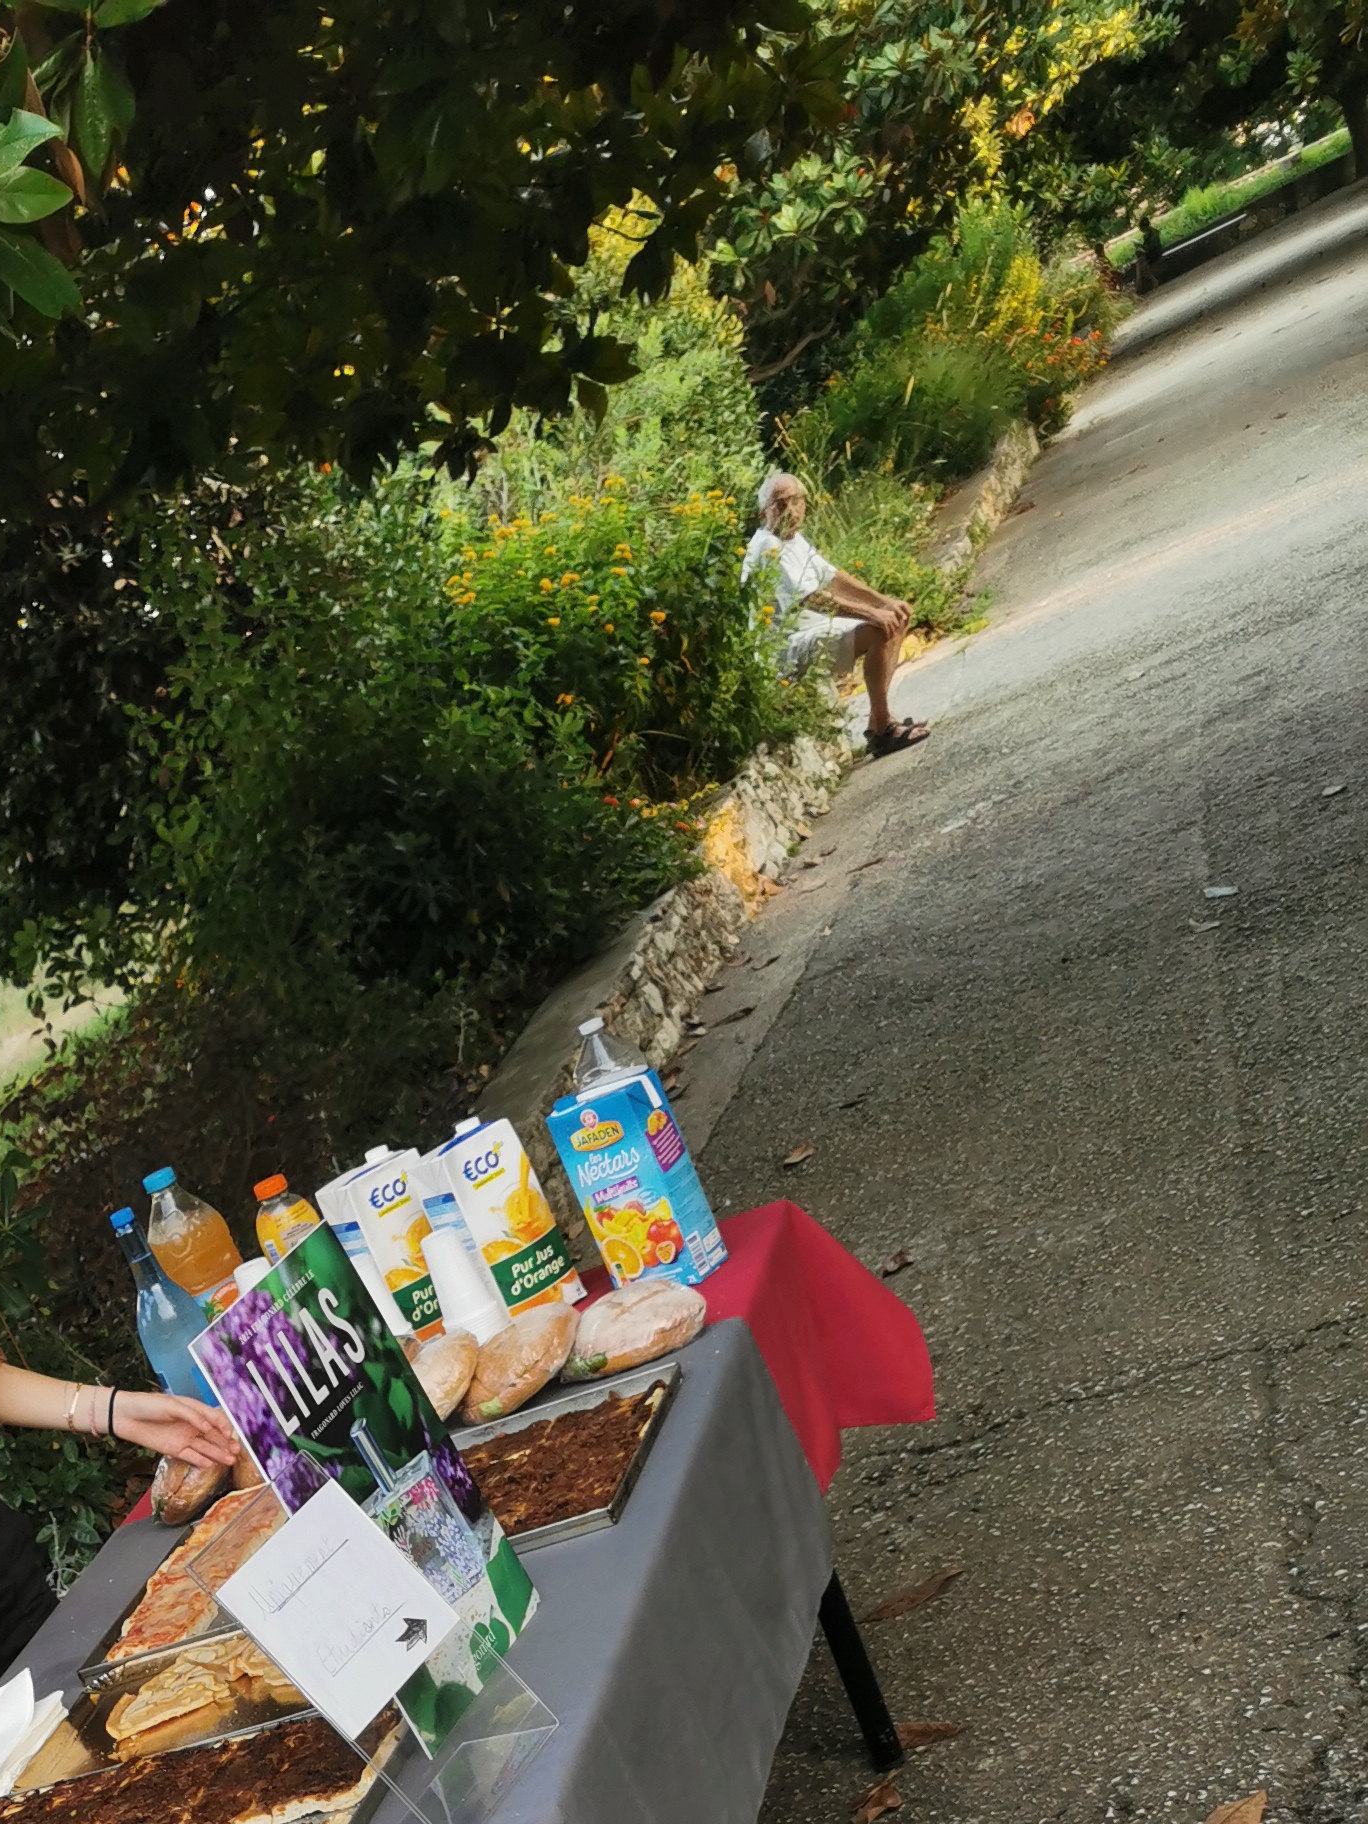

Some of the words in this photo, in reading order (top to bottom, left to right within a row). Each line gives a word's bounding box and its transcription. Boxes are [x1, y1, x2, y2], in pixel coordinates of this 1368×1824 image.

[576, 1123, 620, 1148] JAFADEN
[577, 1147, 641, 1187] Nectars
[510, 1255, 565, 1296] d'Orange
[511, 1256, 534, 1278] Pur
[535, 1244, 554, 1266] Jus
[412, 1297, 438, 1322] d'Or
[246, 1288, 365, 1437] LILAS
